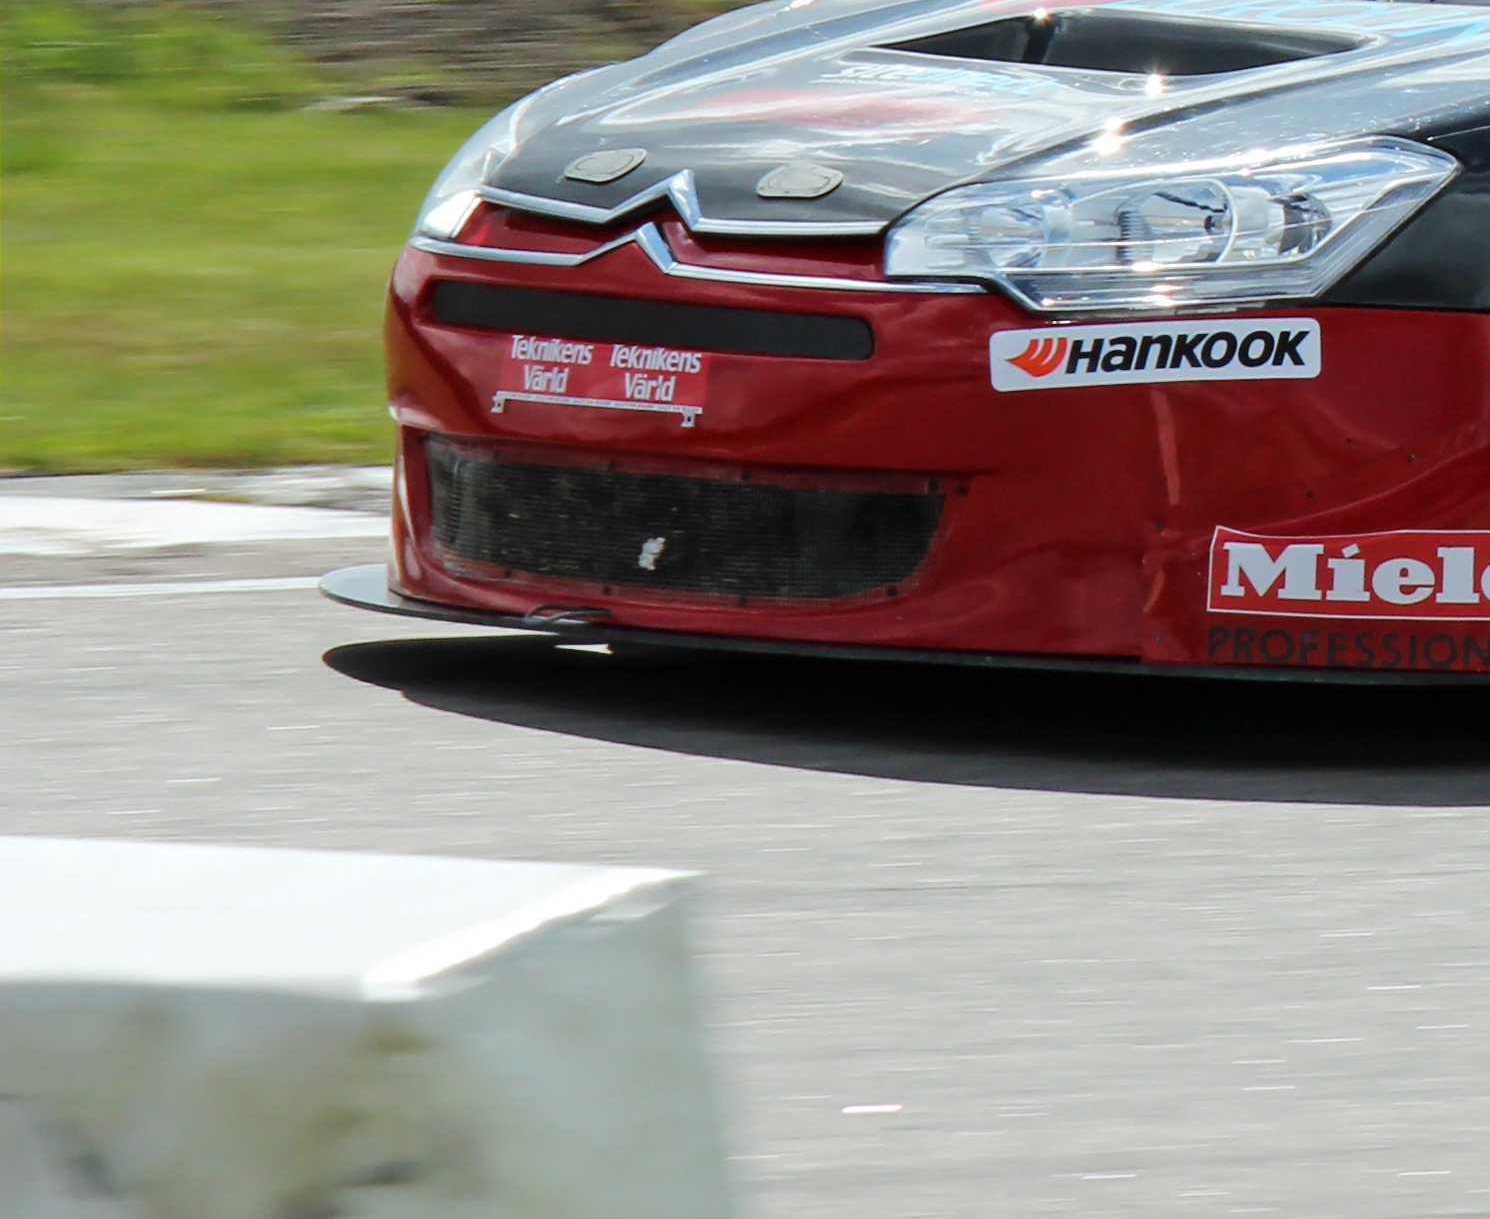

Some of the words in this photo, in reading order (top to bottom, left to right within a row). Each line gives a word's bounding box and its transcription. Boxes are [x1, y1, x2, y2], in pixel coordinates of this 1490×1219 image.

[510, 334, 594, 365] Teknikens
[609, 344, 702, 374] Teknikens
[523, 364, 569, 393] Värld
[624, 372, 676, 401] Värld
